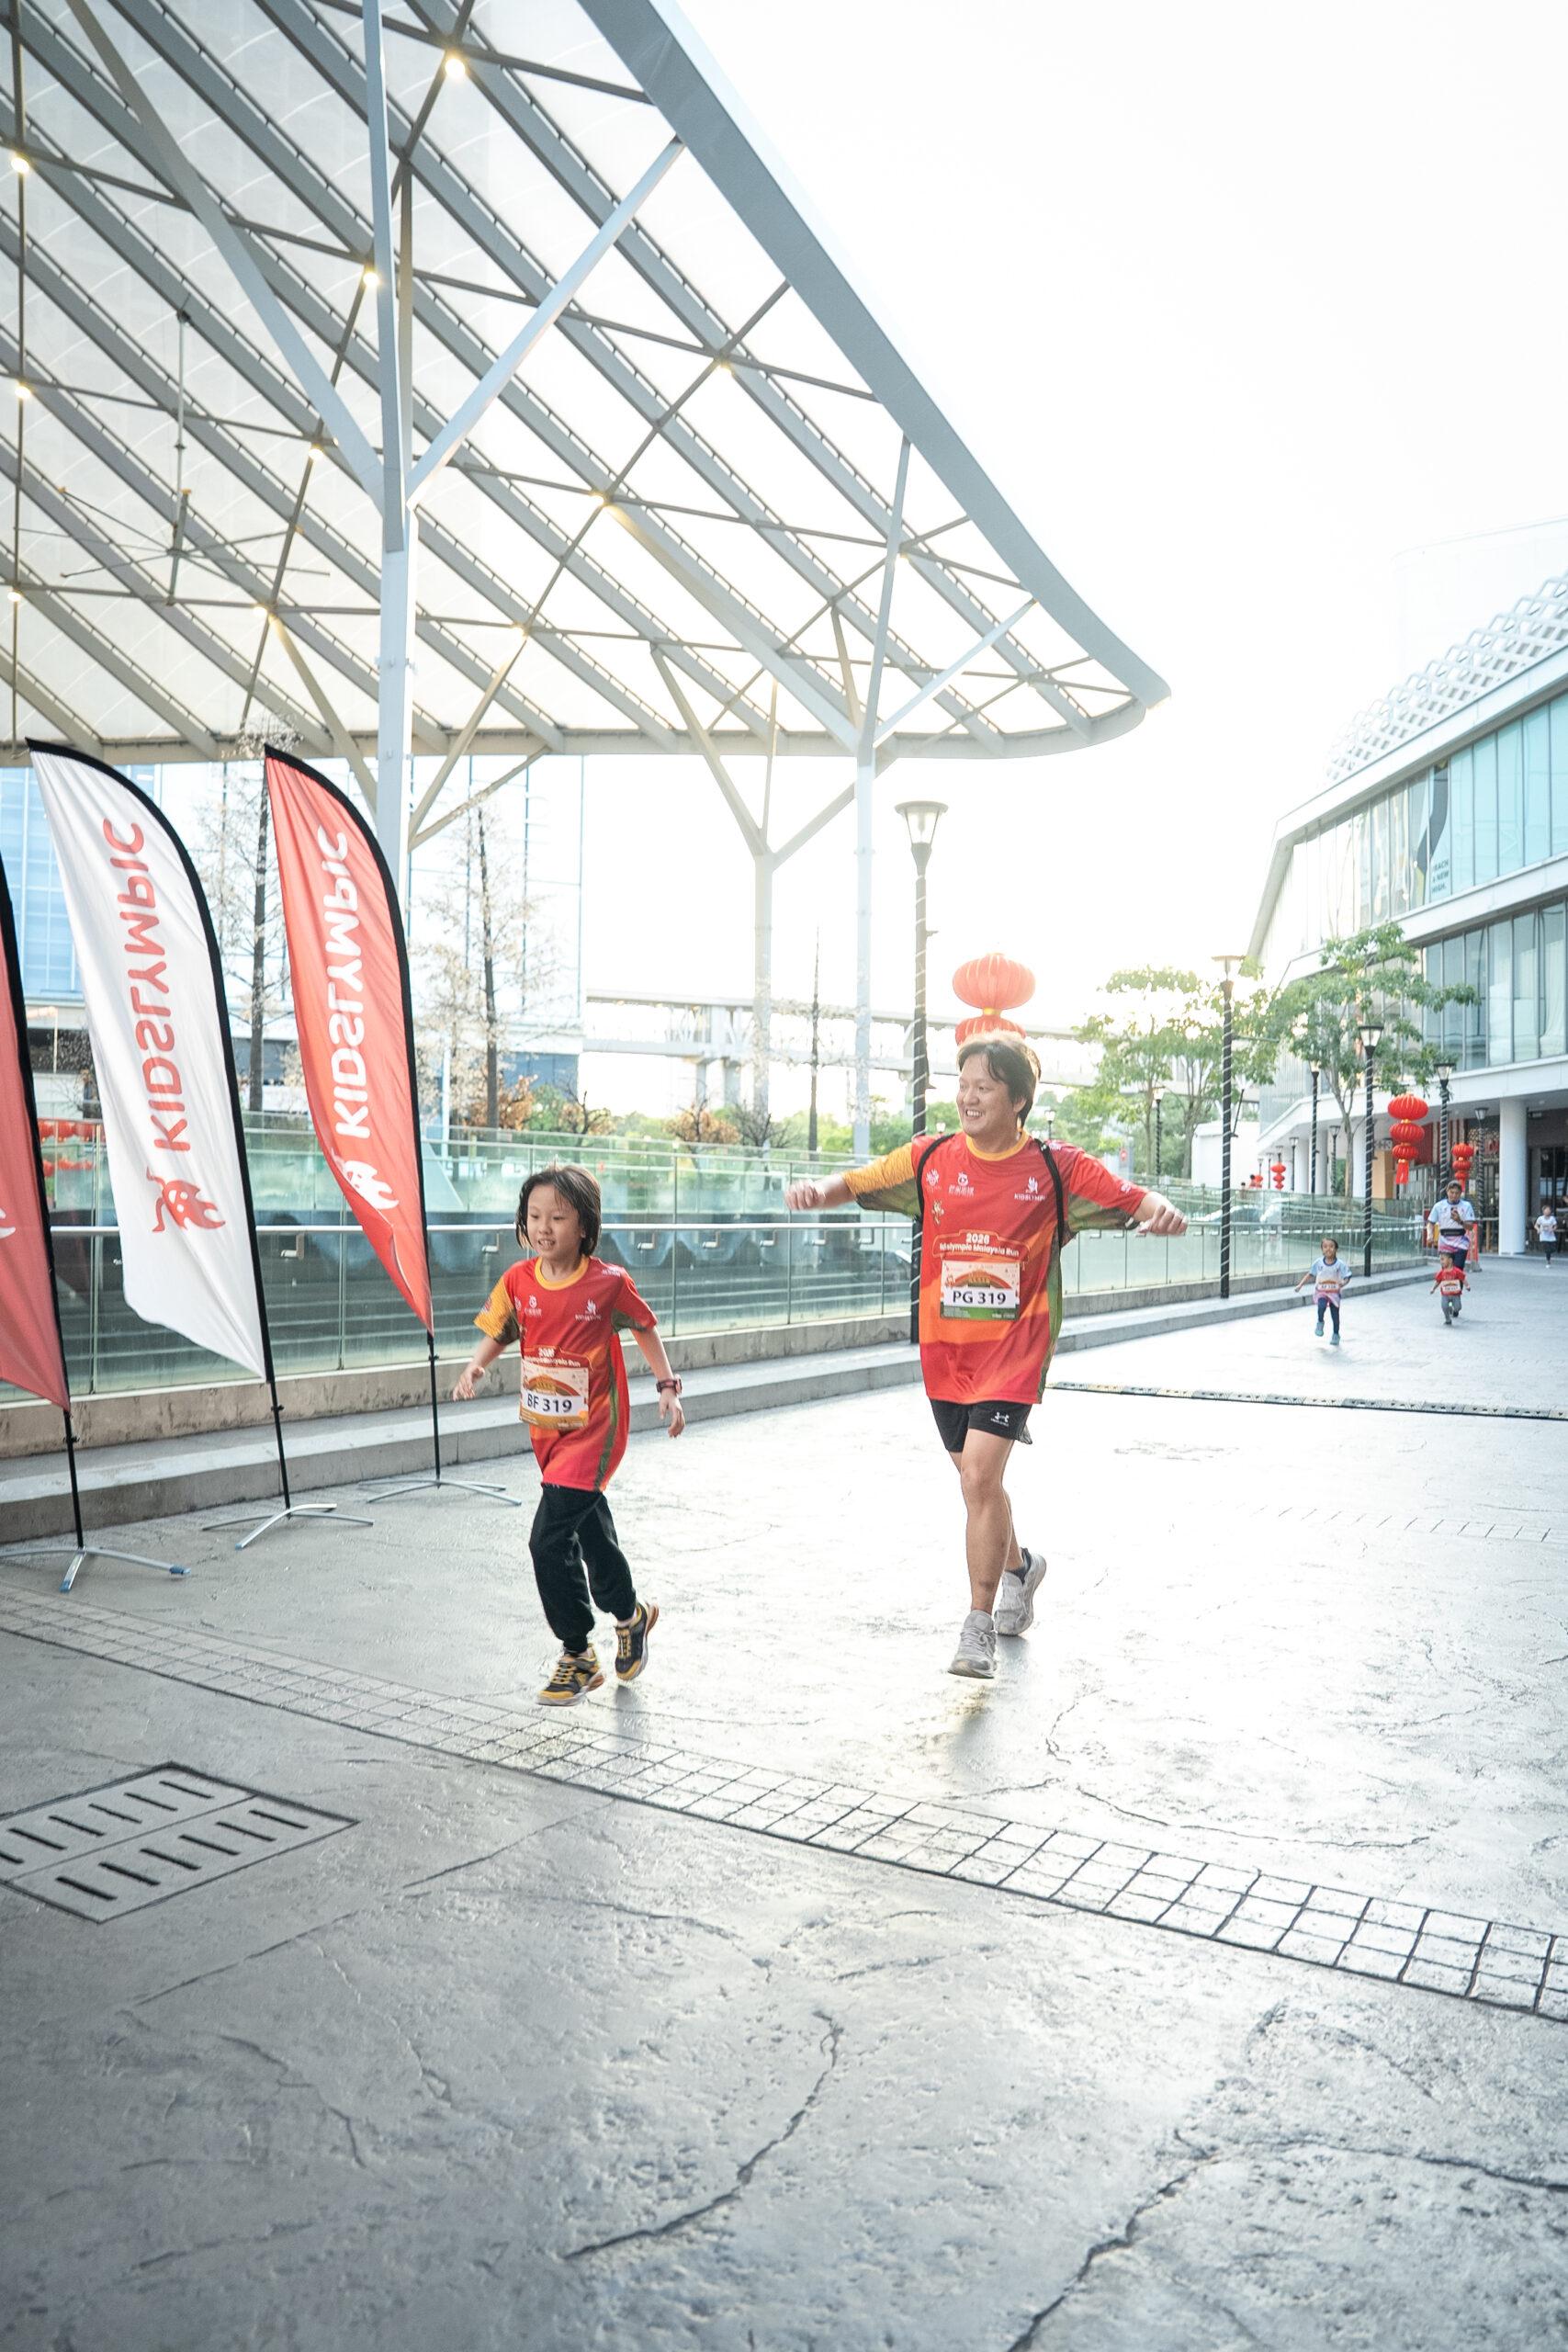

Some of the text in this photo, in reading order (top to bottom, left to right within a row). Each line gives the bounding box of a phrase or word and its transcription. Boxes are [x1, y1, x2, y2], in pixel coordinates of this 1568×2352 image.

[973, 1244, 1005, 1256] Malaysia
[1006, 1248, 1020, 1258] Run
[953, 1290, 1007, 1306] PG 319
[527, 1393, 573, 1413] BF 319
